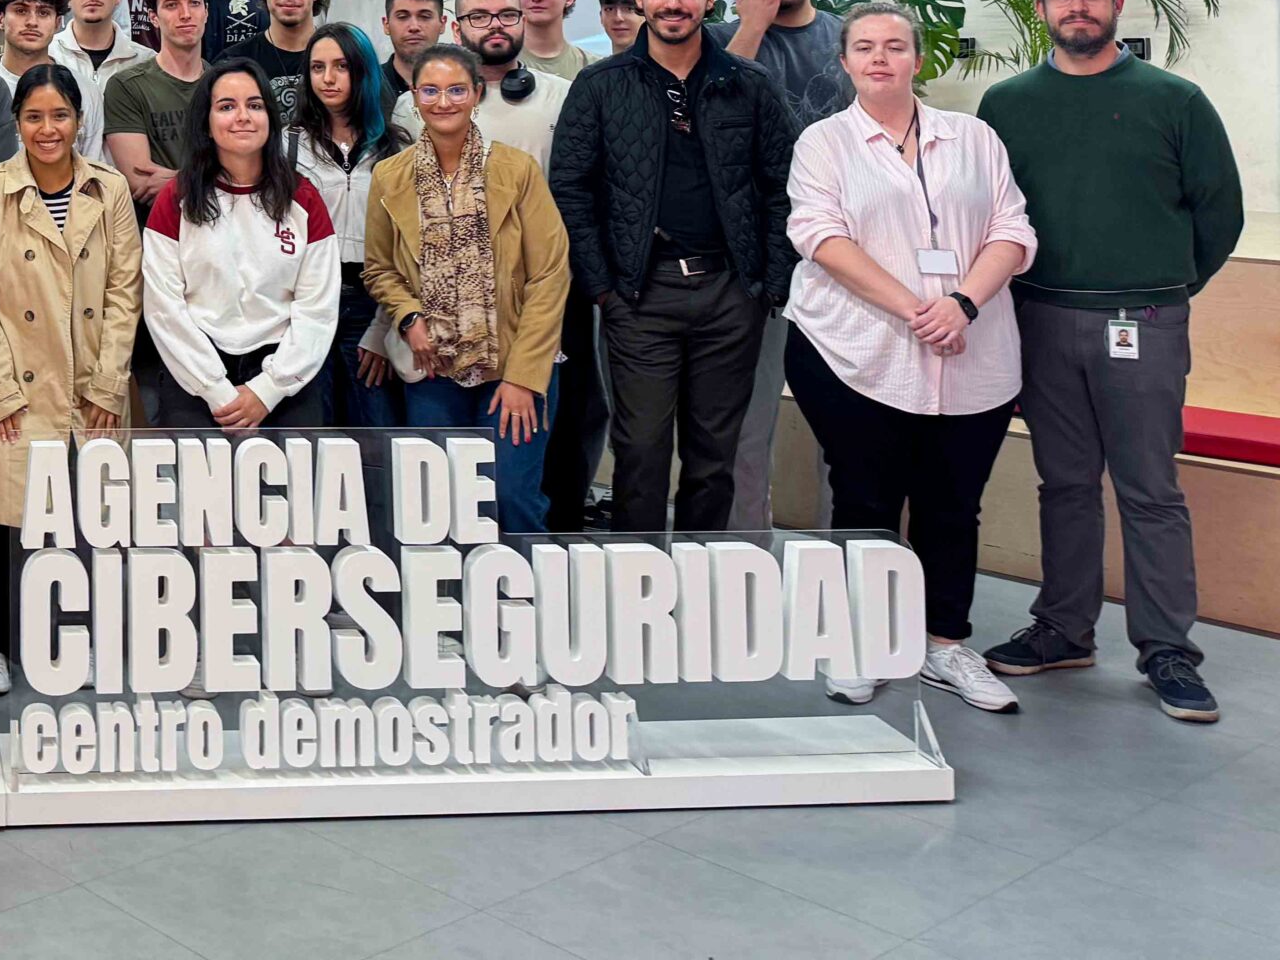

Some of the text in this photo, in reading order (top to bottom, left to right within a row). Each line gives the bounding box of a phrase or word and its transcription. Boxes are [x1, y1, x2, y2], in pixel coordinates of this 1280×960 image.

[20, 436, 500, 549] AGENCIA DE
[20, 539, 927, 696] CIBERSEGURIDAD
[21, 684, 636, 775] centro demostrador
